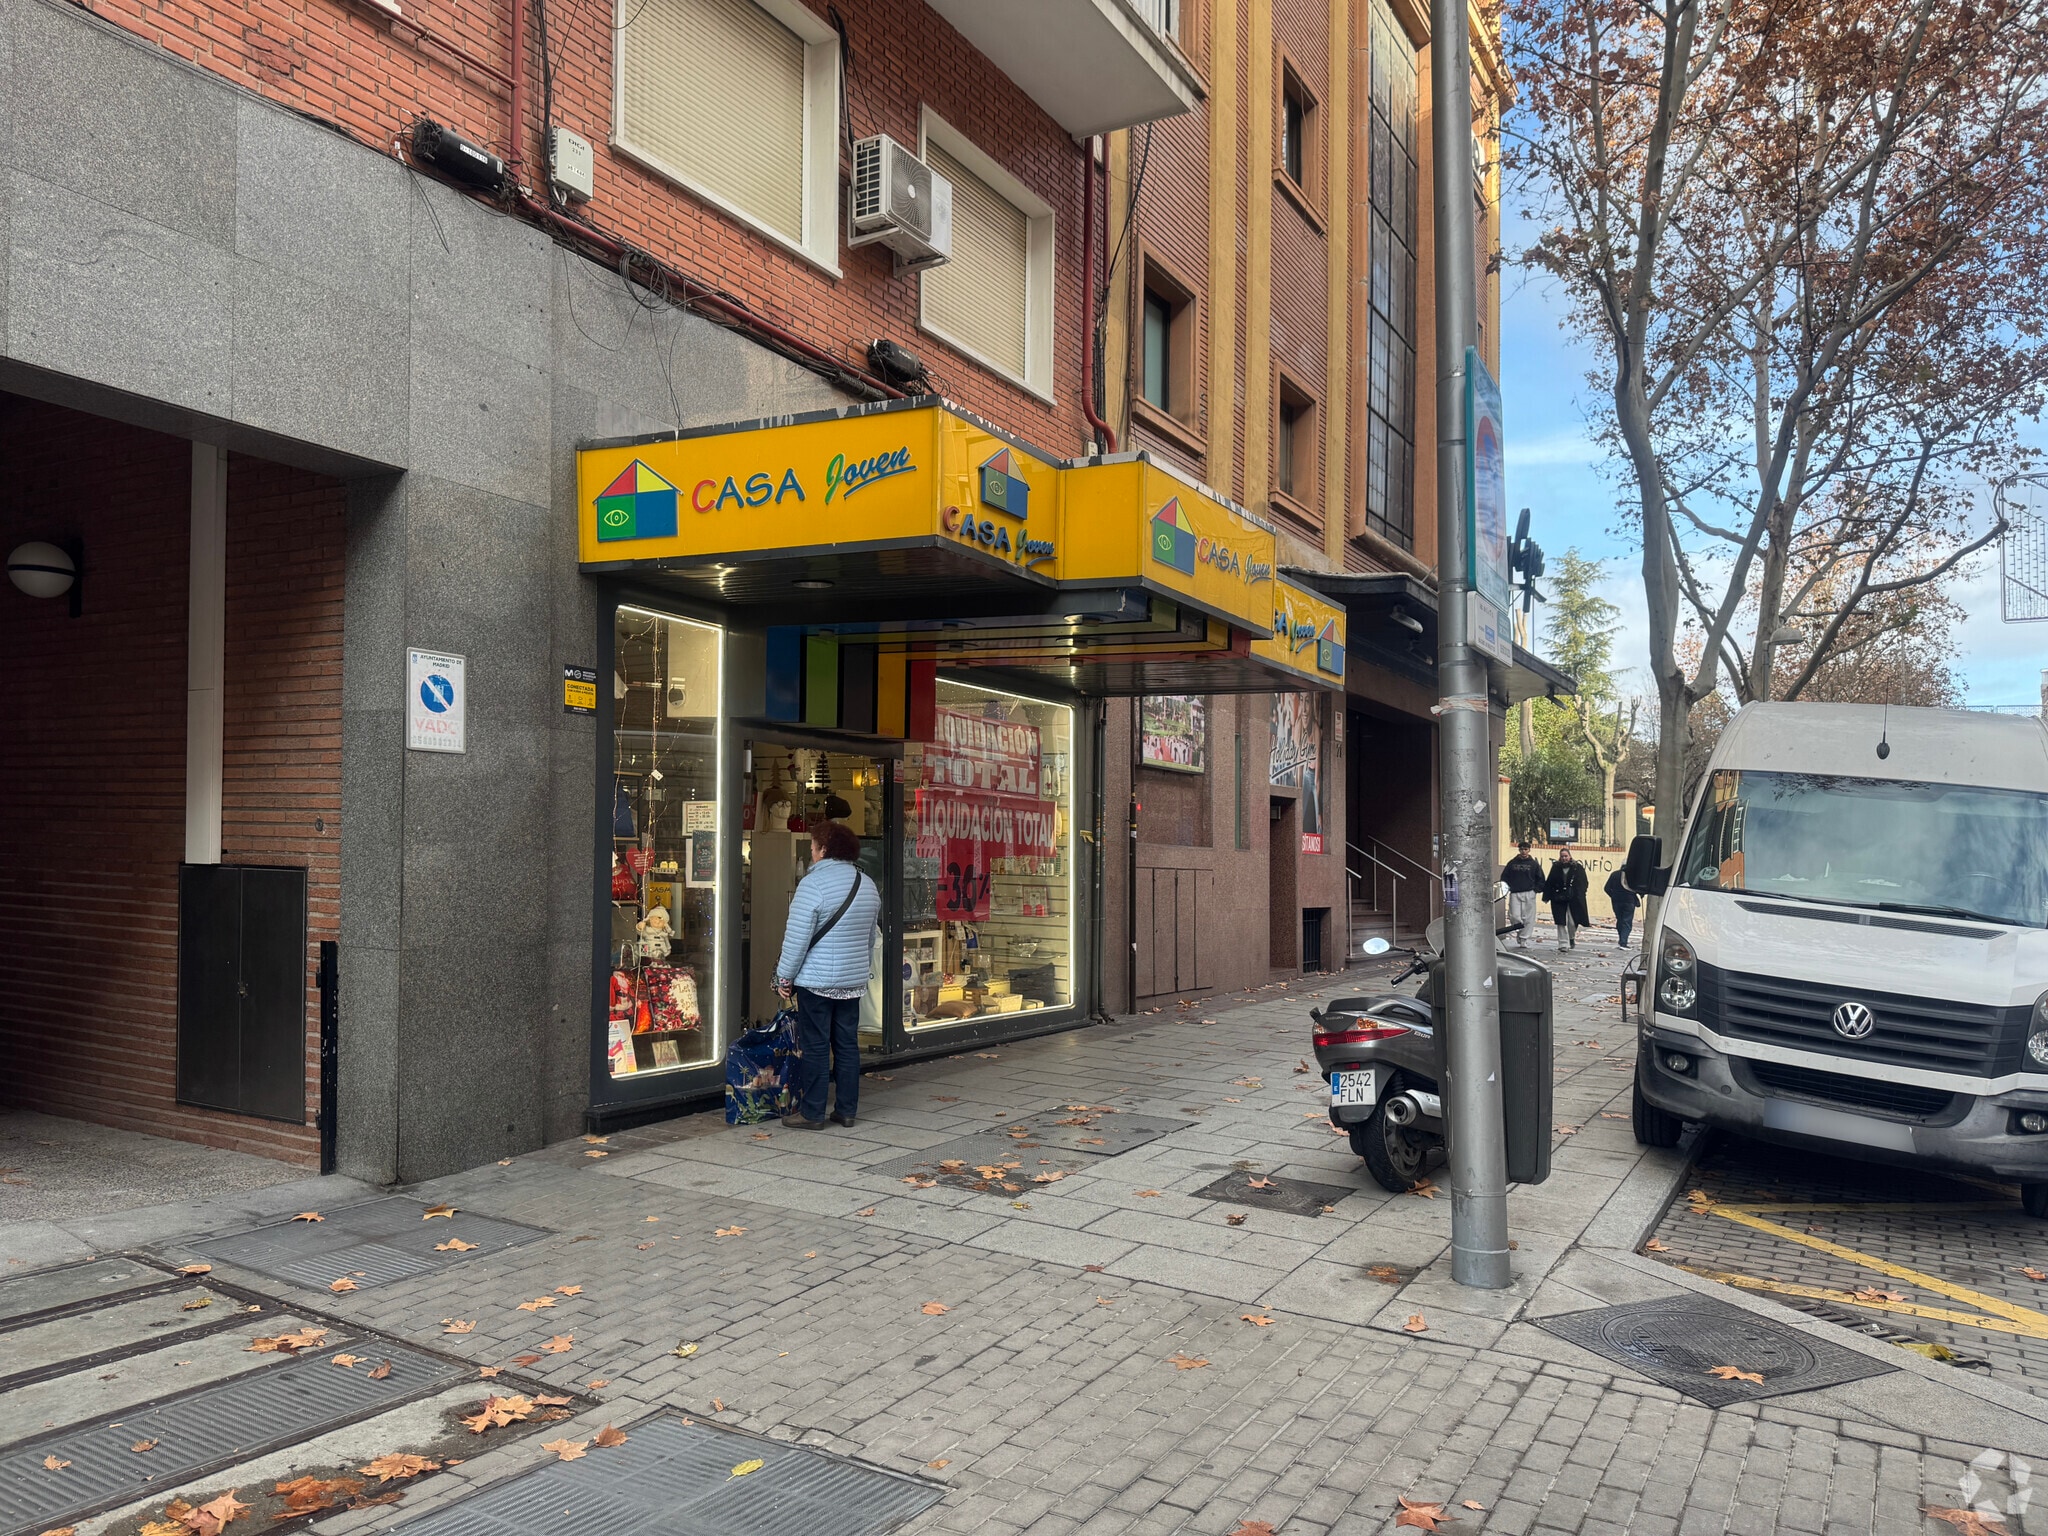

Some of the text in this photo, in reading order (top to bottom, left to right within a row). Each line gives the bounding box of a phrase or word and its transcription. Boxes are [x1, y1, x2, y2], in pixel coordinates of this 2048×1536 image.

[691, 446, 913, 513] CASA Joven
[943, 505, 1055, 564] CASA Joven
[1197, 537, 1271, 585] CASA Joven
[1290, 619, 1316, 651] Joven
[420, 654, 456, 664] AYUNTAMIENTO
[935, 713, 1038, 756] IQUIDACIÓN
[925, 753, 1037, 795] TOTAL
[921, 797, 1055, 848] LIQUIDACIÓN TOTAL
[1340, 1072, 1371, 1088] 2542
[1340, 1087, 1364, 1103] FLN
